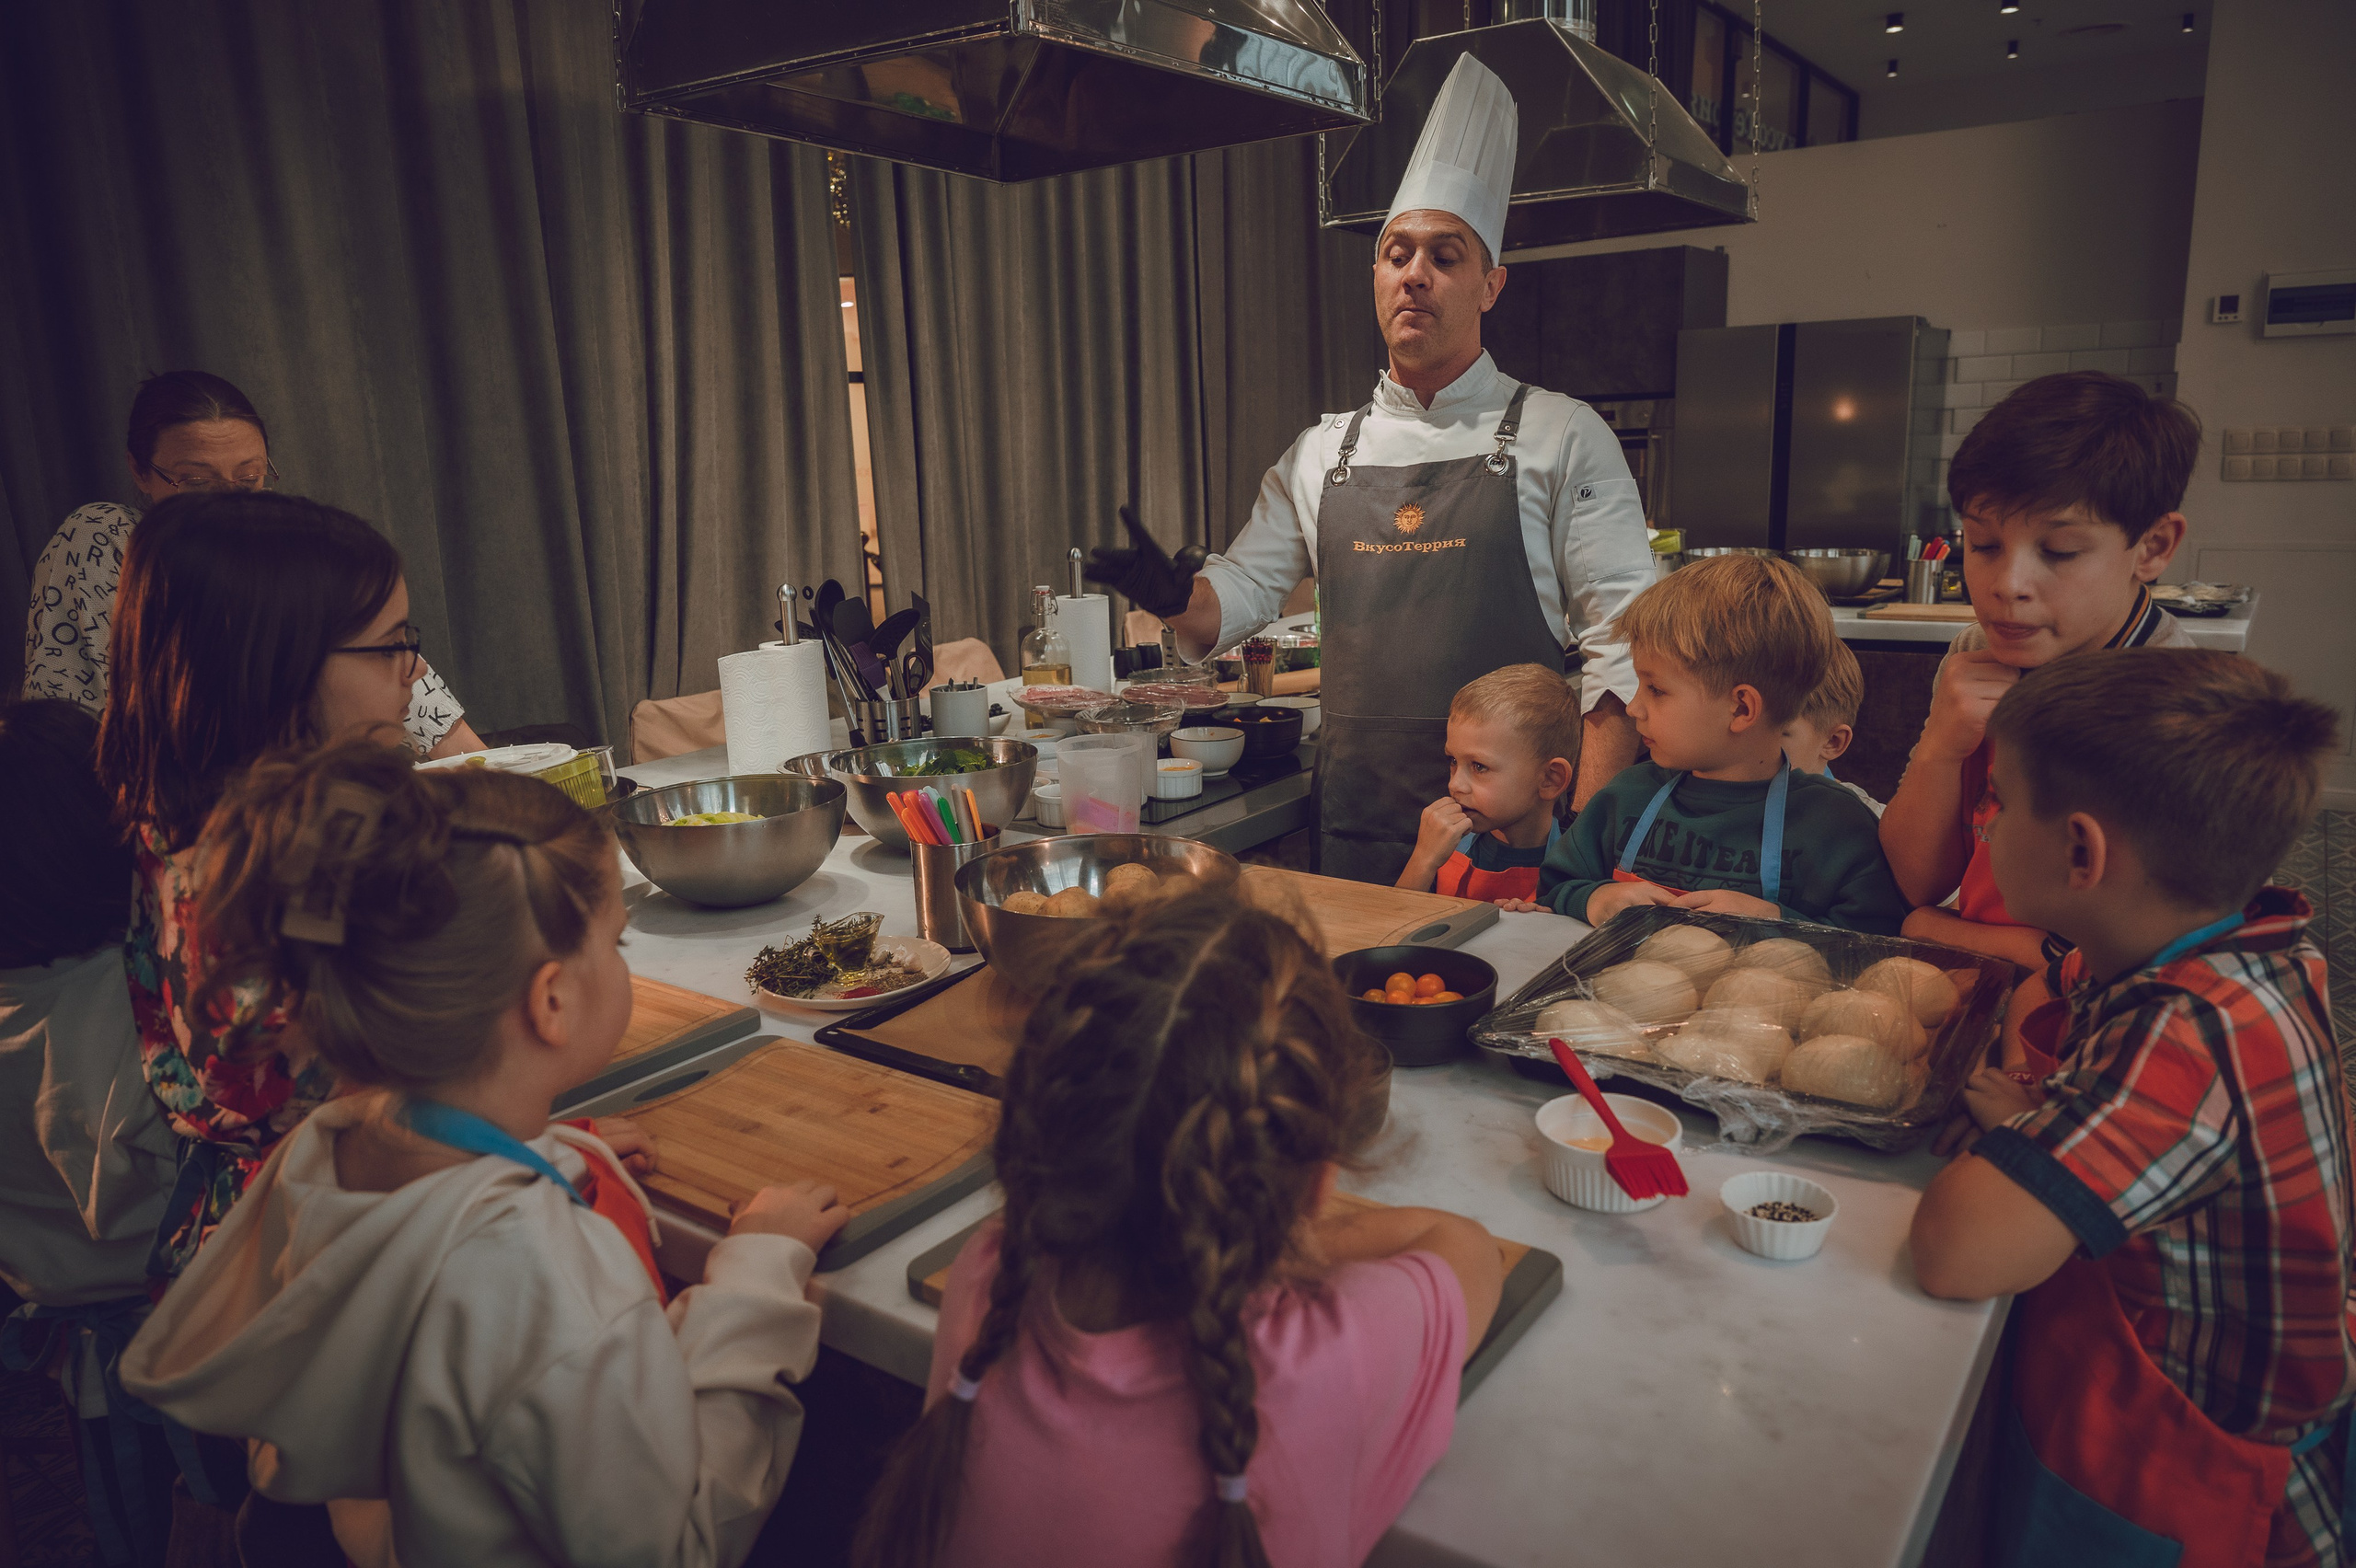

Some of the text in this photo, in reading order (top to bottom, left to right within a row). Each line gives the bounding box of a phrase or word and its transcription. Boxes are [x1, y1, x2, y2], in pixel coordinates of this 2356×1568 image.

[1353, 538, 1466, 555] ВкусоТеррия
[1617, 816, 1803, 880] TKE IT EAY
